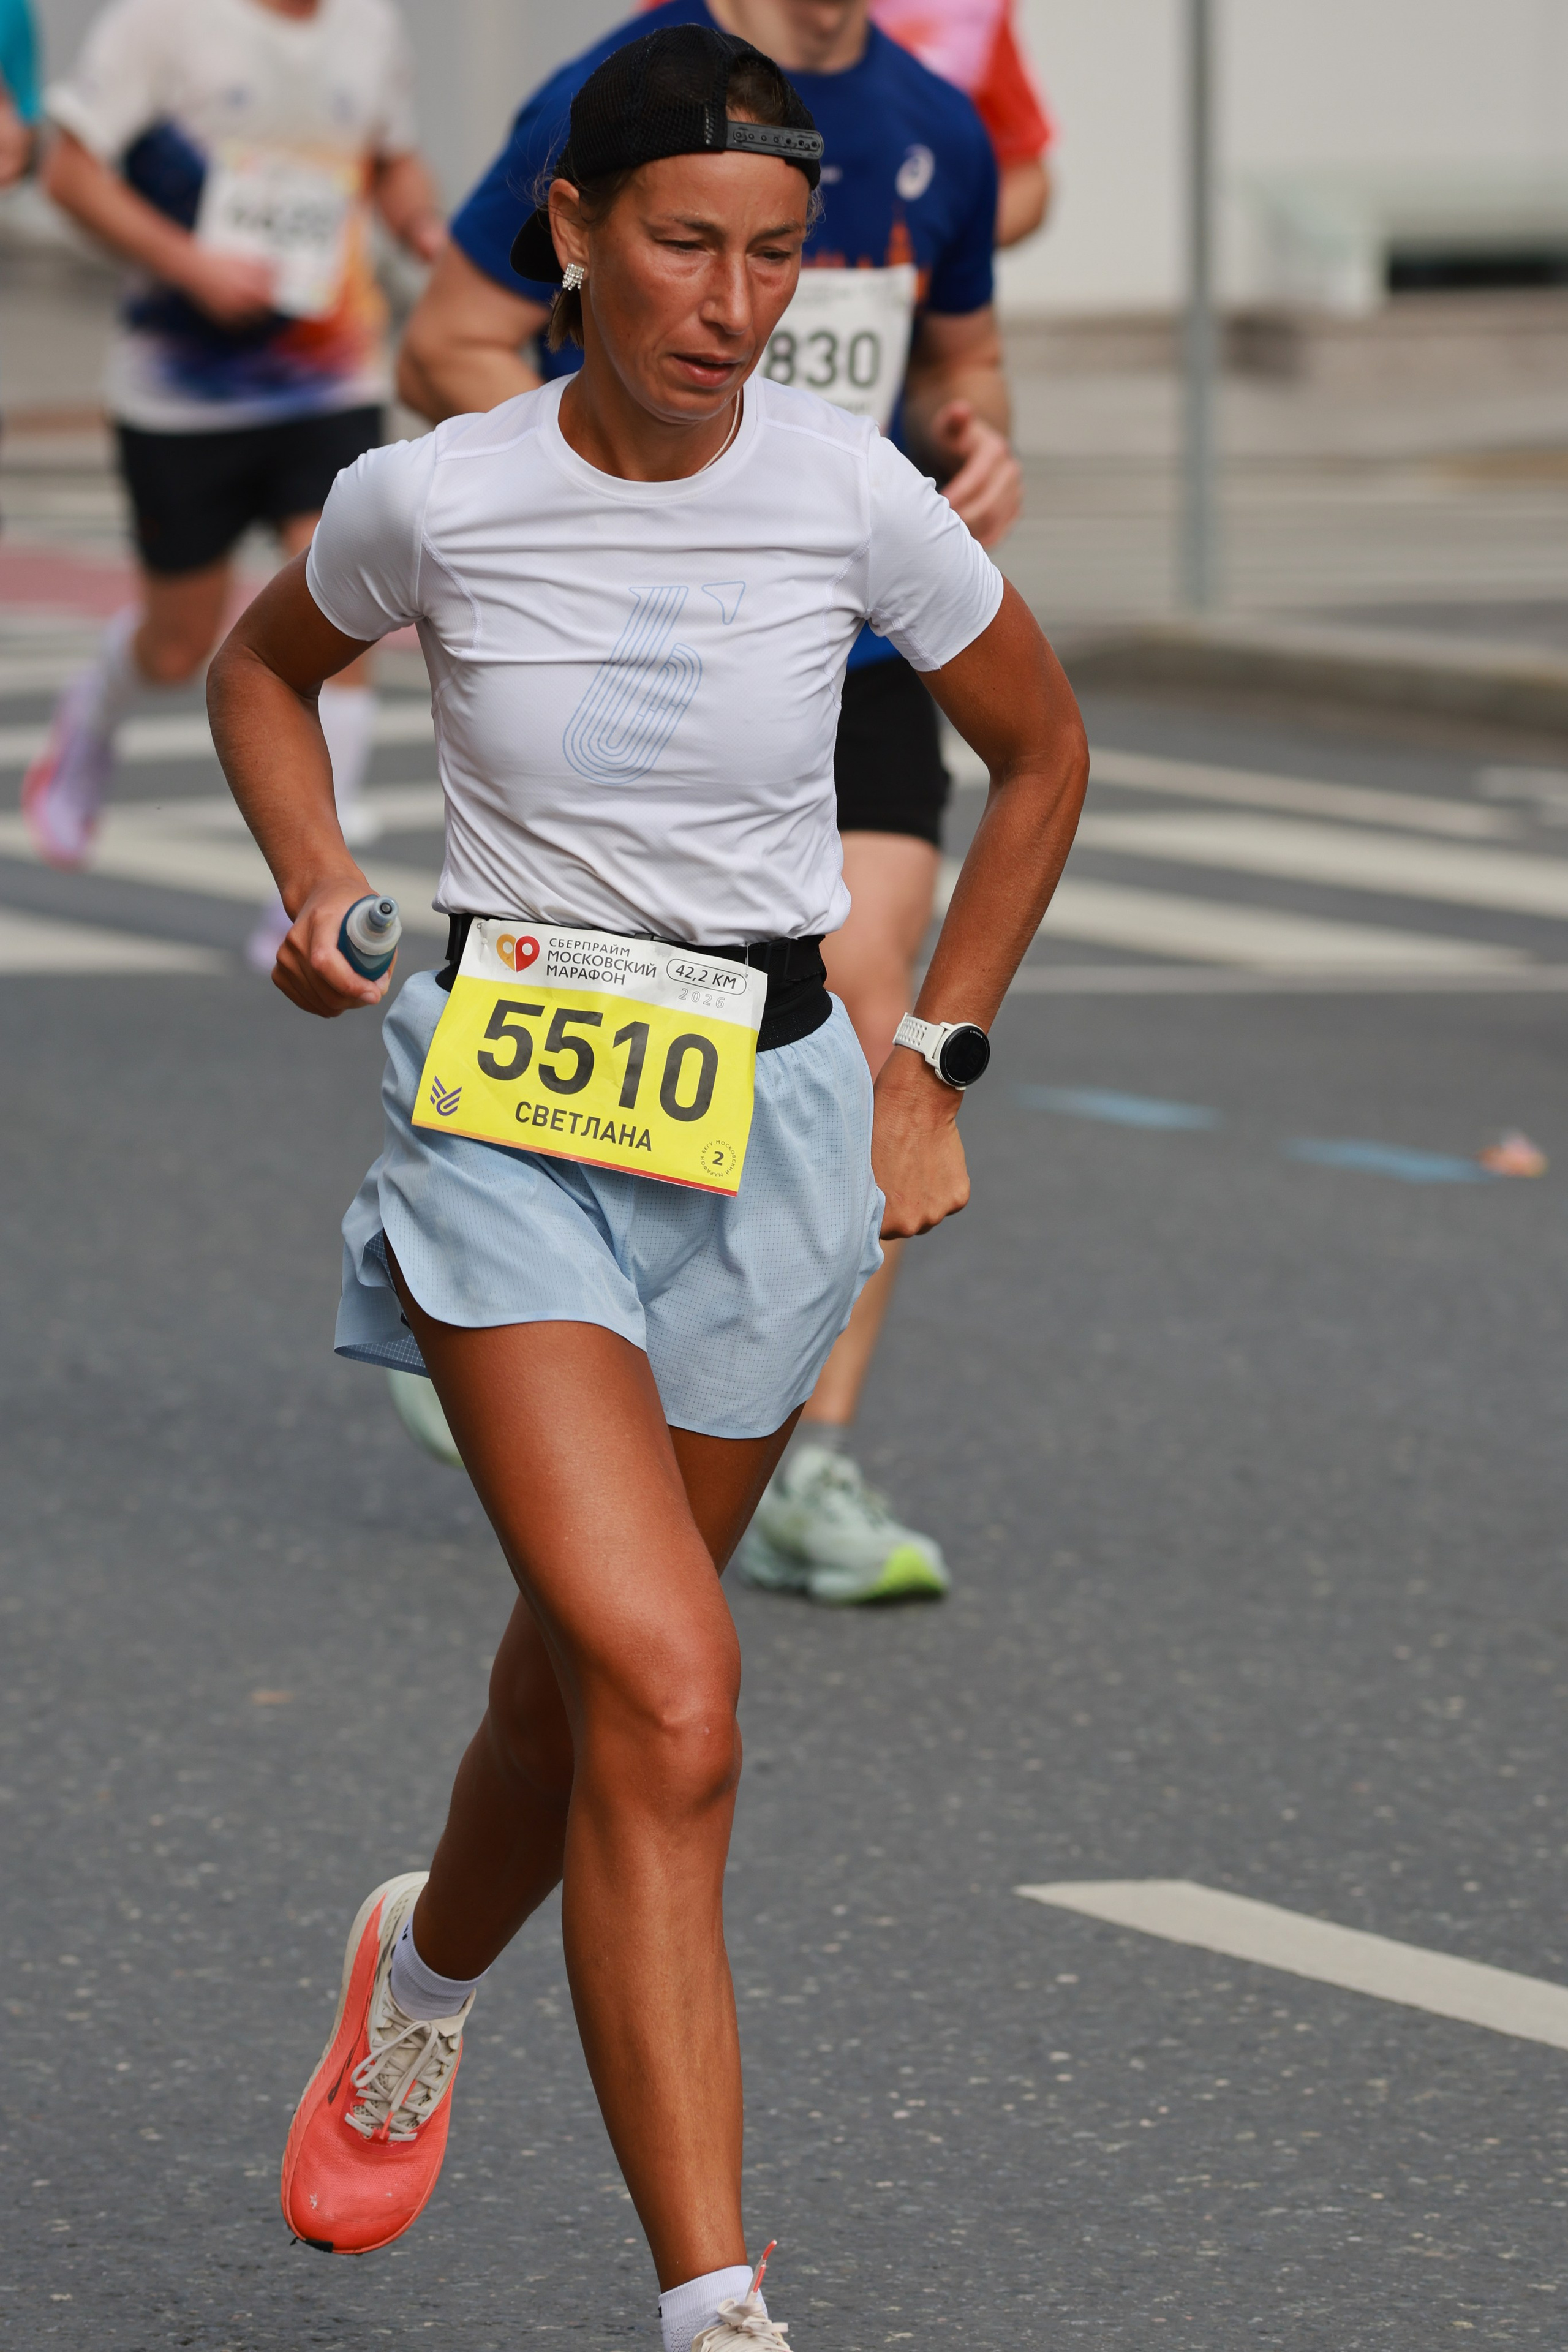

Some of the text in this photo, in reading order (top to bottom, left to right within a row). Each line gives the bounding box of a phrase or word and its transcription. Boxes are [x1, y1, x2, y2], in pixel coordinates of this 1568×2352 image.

[764, 330, 881, 388] 830
[549, 938, 630, 957] СБЕРПРАЙМ
[546, 965, 625, 985] МАРАФОН
[547, 950, 657, 978] МОСКОВСКИЙ
[675, 964, 737, 989] 42,2 КМ
[678, 988, 725, 1009] 2026
[477, 998, 718, 1122] 5510
[515, 1101, 652, 1152] СВЕТЛАНА
[701, 1140, 736, 1177] БЕГУ МОСКОВСКИЙ МАРАФОН
[712, 1151, 724, 1166] 2
